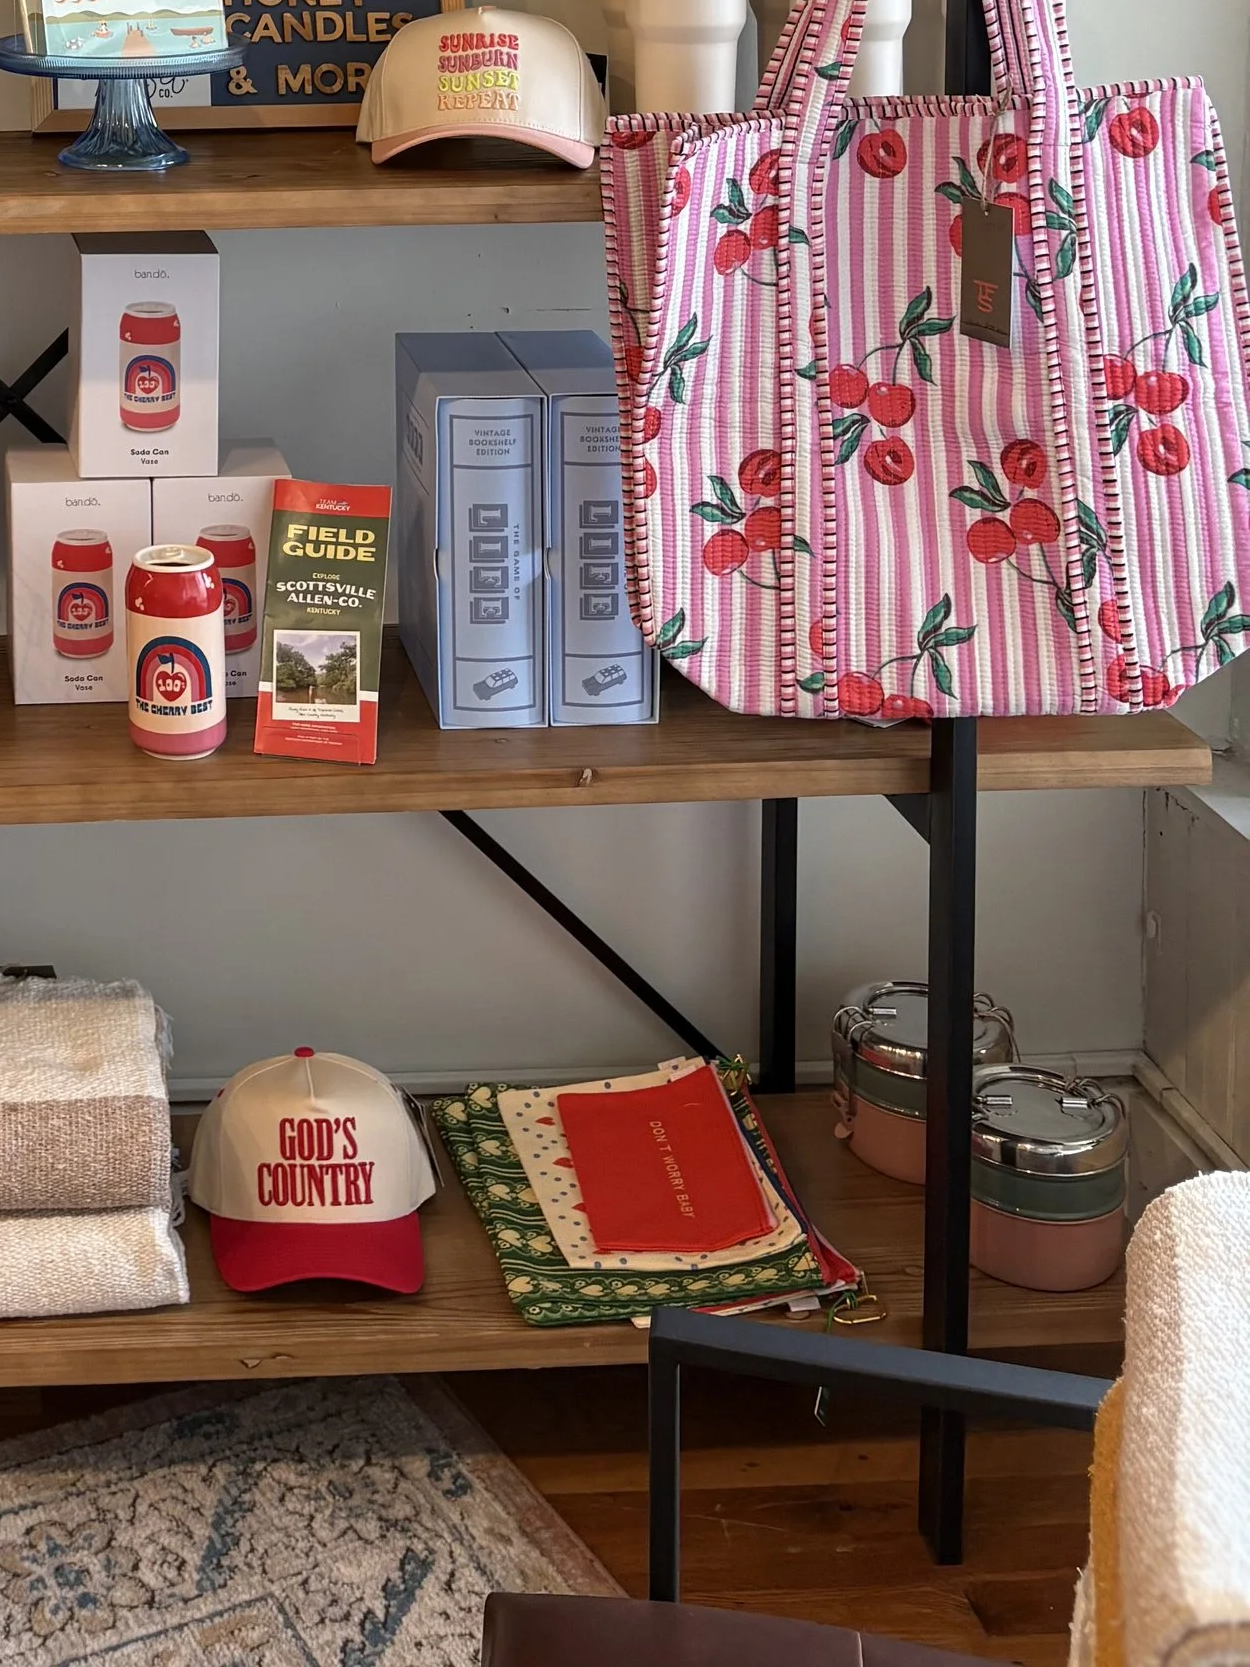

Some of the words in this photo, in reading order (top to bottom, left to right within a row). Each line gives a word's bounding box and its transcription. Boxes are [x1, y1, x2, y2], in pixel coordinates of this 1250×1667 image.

[225, 10, 413, 44] CANDLES
[438, 32, 519, 53] SUNRISE
[437, 50, 519, 71] SUNBURN
[226, 65, 259, 96] &
[277, 62, 374, 96] MOR
[438, 71, 520, 92] SUNSET
[159, 88, 173, 98] CO.
[437, 91, 520, 111] REPEAT
[134, 394, 160, 404] CHERRY
[474, 429, 511, 437] VINTAGE
[130, 448, 150, 456] Soda
[152, 448, 169, 456] Can
[476, 448, 510, 456] EDITION
[316, 503, 350, 511] KENTUCKY
[287, 523, 376, 544] FIELD
[282, 541, 376, 562] GUIDE
[589, 505, 613, 615] LIFE
[477, 508, 502, 618] LIFE
[312, 572, 340, 581] EXPLORE
[276, 580, 377, 600] SCOTTSVILLE
[514, 586, 520, 600] OF
[287, 592, 363, 608] ALLEN-CO.
[306, 607, 341, 615] KENTUCKY
[67, 621, 94, 631] CHERRY
[64, 674, 85, 682] Soda
[87, 674, 104, 682] Can
[231, 670, 247, 678] Can
[136, 700, 150, 714] THE
[151, 704, 188, 717] CHERRY
[190, 699, 213, 715] BEST
[278, 1116, 358, 1162] GOD'S
[257, 1161, 375, 1208] COUNTRY
[663, 1151, 686, 1193] WORRY
[676, 1191, 695, 1221] BABY
